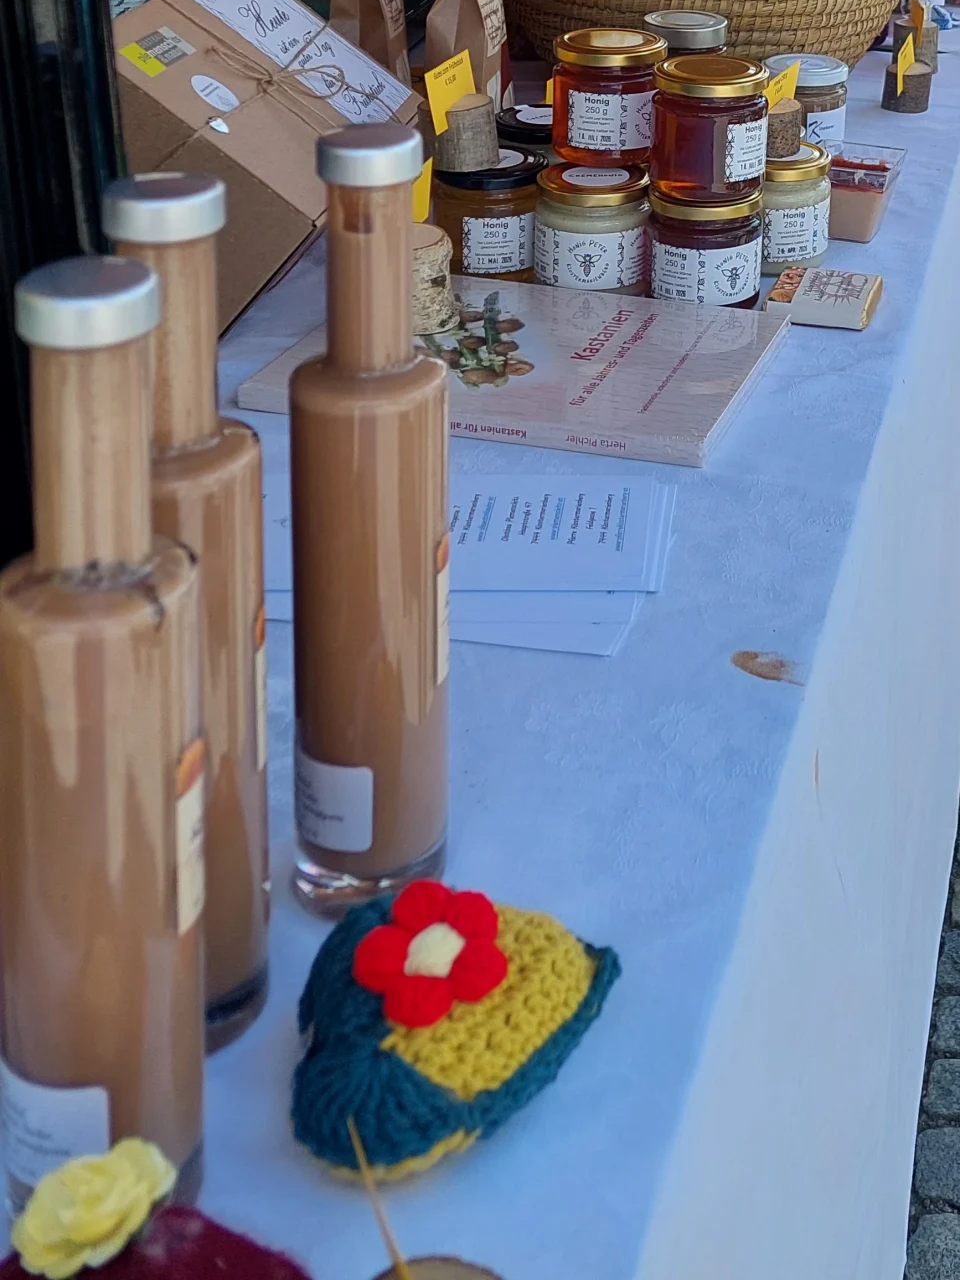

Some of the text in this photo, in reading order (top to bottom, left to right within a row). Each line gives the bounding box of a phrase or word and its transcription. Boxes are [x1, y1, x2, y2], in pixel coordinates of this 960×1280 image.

[238, 0, 290, 38] Heute
[584, 96, 610, 106] Honig
[586, 106, 608, 116] 250 g
[745, 124, 762, 134] Honig
[746, 135, 756, 143] 250
[567, 240, 608, 254] HONIG PETER
[664, 248, 687, 261] Honig
[665, 259, 686, 270] 250 g
[714, 252, 750, 270] HONIG PETER
[566, 262, 610, 284] KLOSTERMARIENBERG
[664, 287, 674, 295] JULI
[675, 289, 686, 297] 2026
[713, 272, 750, 297] KLOSTERMARIENBERG
[570, 309, 634, 362] Kastanien
[569, 313, 659, 406] für alle Jahres- und Tageszeiten
[450, 421, 527, 439] Kastanien für all
[566, 435, 626, 450] Herta Pichler
[535, 493, 552, 530] Klostermarienberg
[571, 493, 586, 529] Klostermarienberg
[586, 510, 596, 530] Feldgasse
[601, 493, 615, 530] Klostermarienberg
